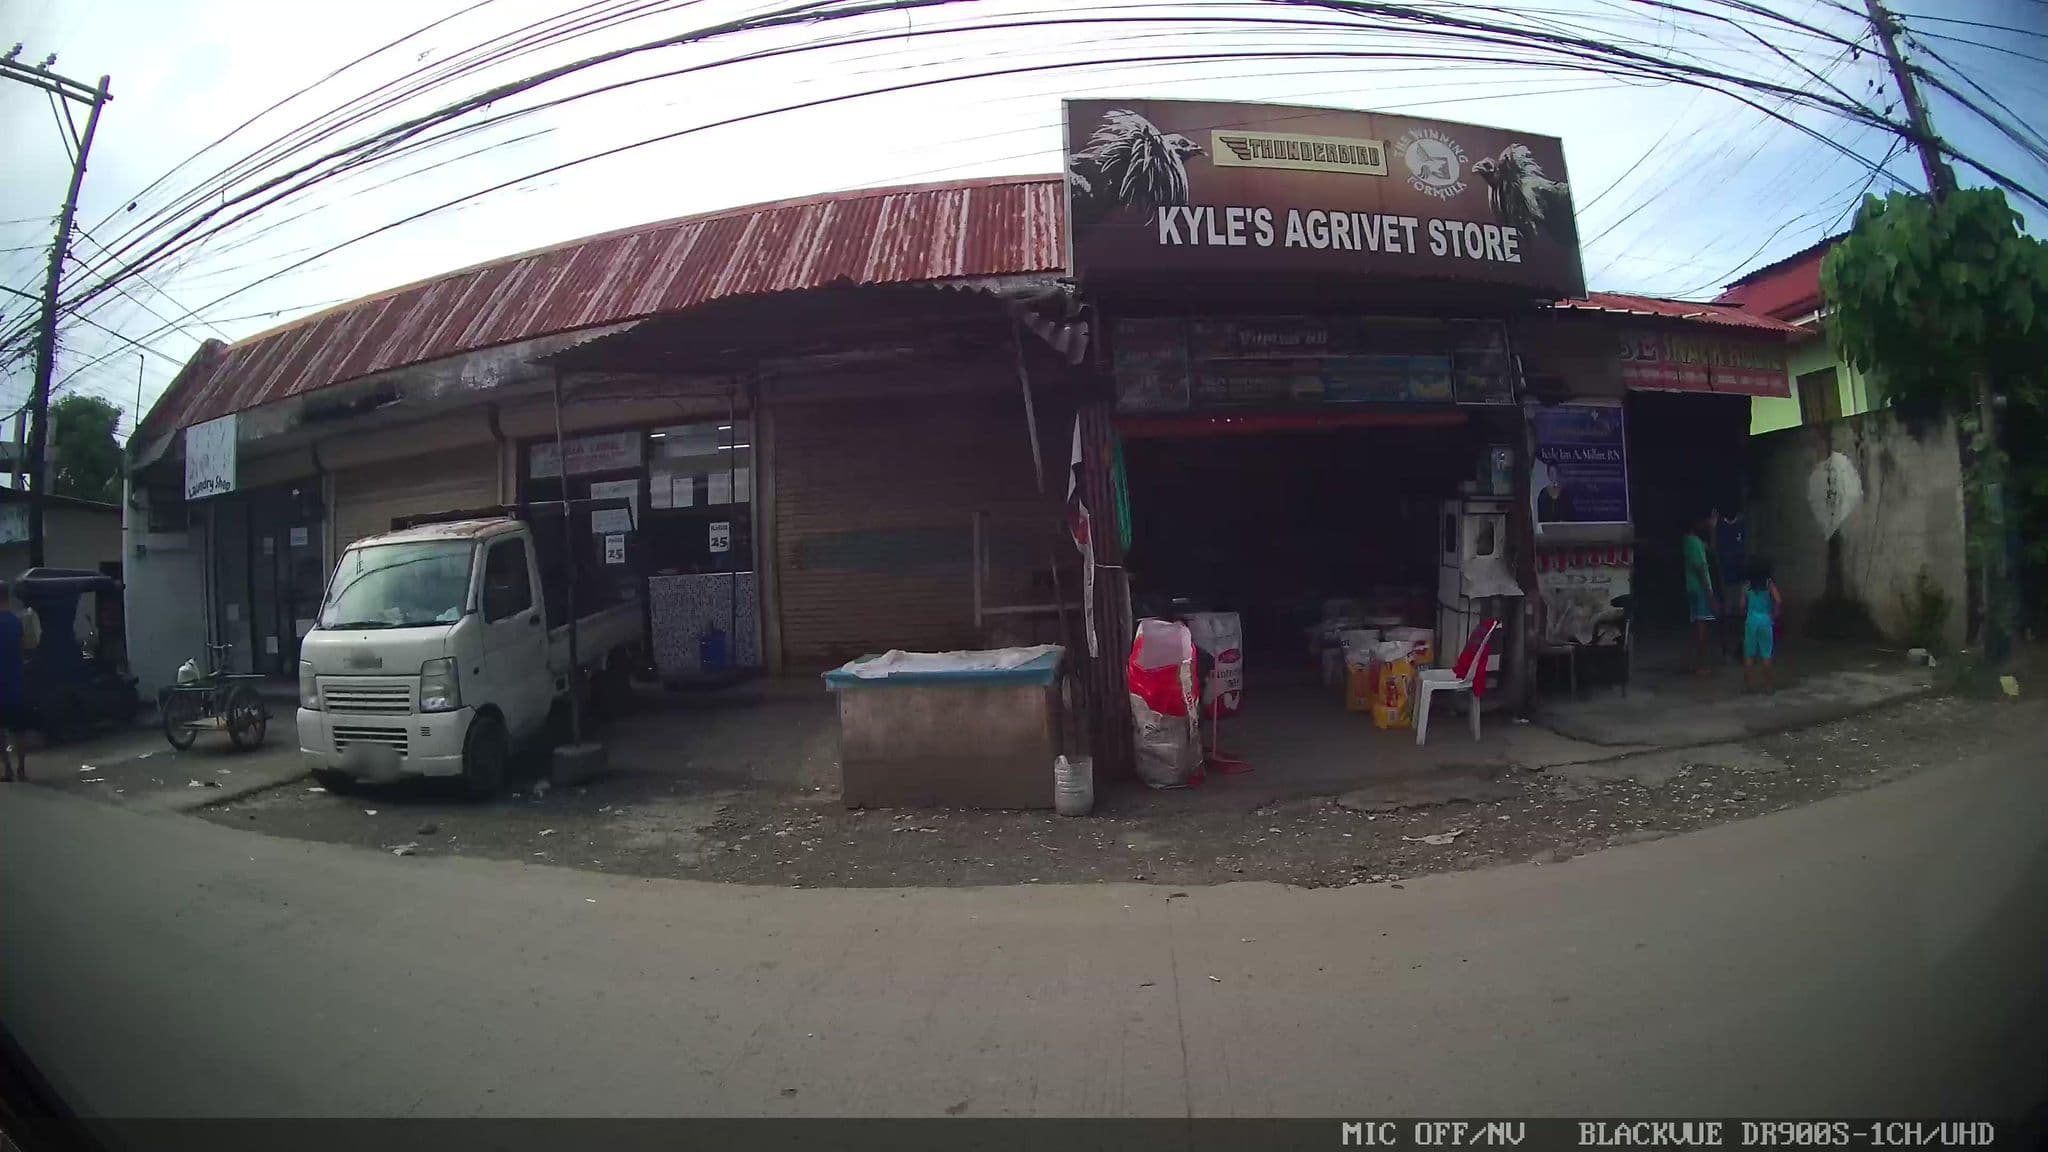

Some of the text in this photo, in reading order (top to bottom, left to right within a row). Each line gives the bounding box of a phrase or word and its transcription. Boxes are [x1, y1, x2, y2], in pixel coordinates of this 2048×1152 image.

[1249, 138, 1380, 167] THUNDERBIRD
[1408, 127, 1468, 164] WINNING
[1407, 176, 1468, 201] FORMULA
[1158, 205, 1521, 264] KYLE'S AGRIVET STORE
[188, 474, 231, 498] Laundry Shop
[608, 548, 623, 559] 25
[711, 537, 728, 547] 25
